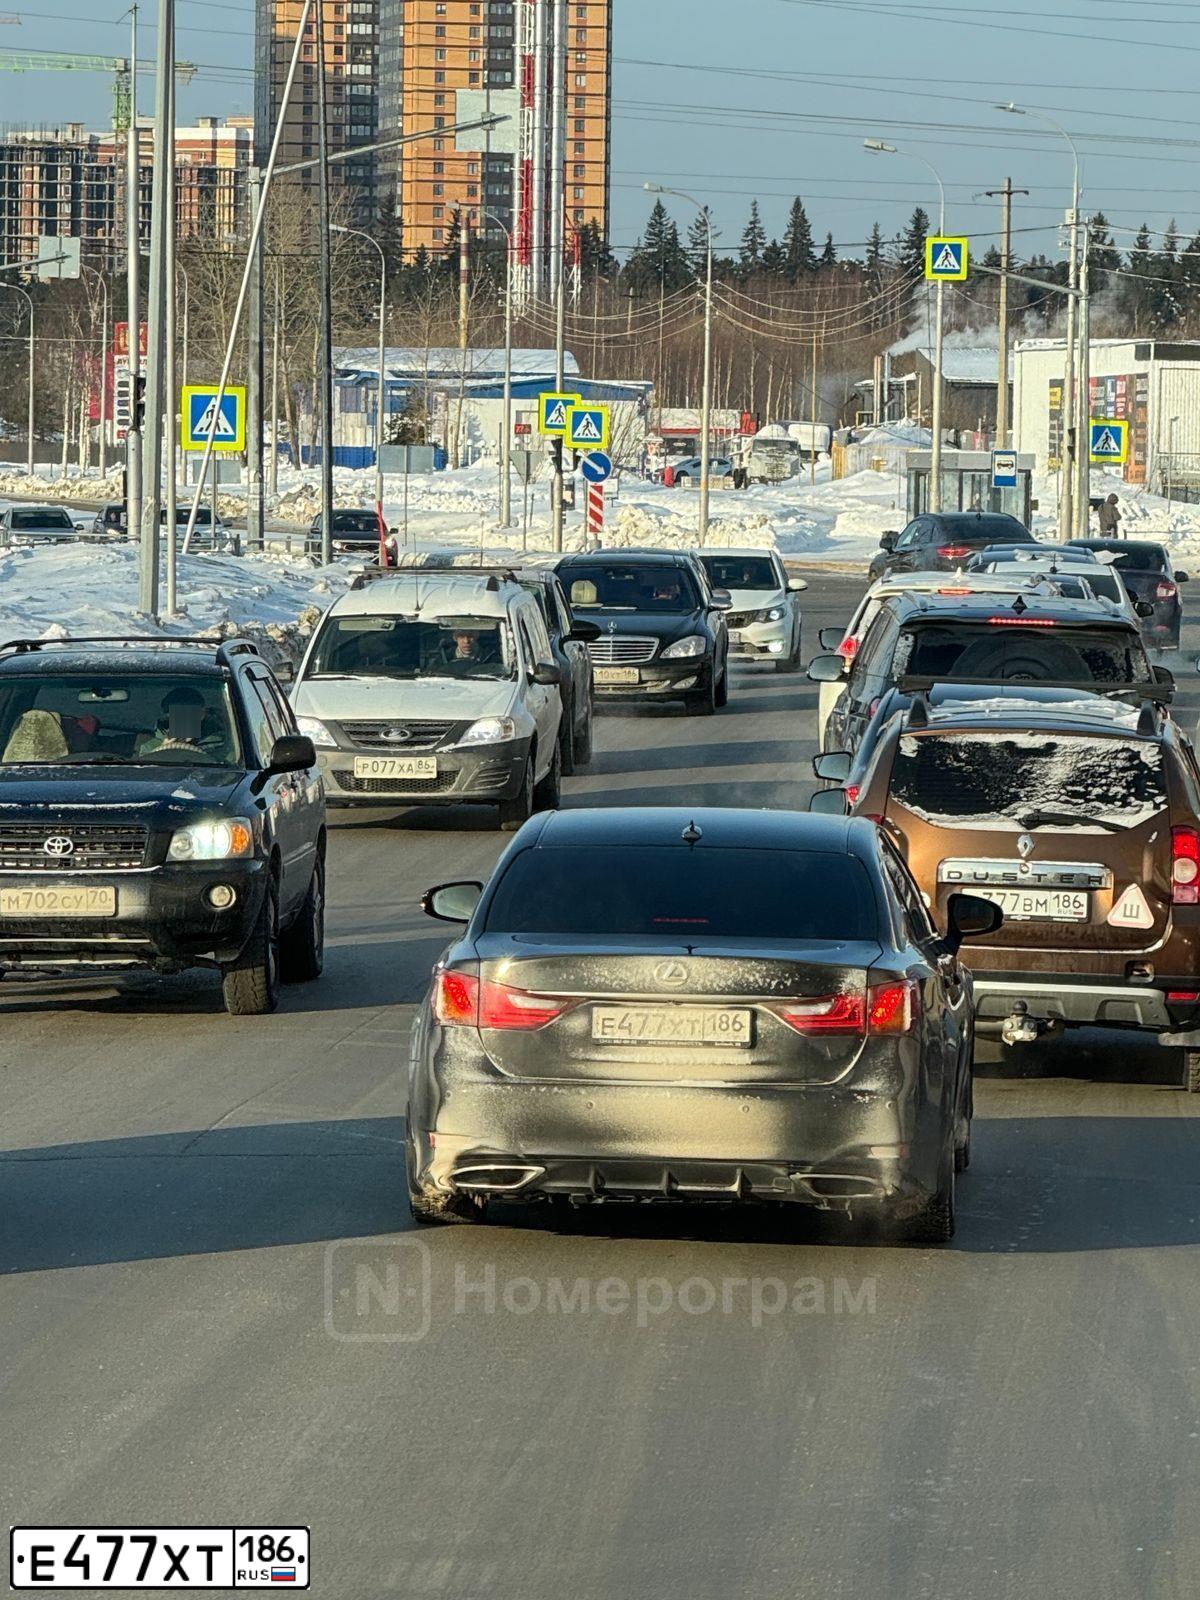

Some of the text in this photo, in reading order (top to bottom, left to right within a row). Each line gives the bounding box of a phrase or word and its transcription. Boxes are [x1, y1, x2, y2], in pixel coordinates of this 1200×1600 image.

[362, 760, 430, 774] Р077ХА 86
[947, 870, 1103, 886] DUSTER
[7, 890, 108, 909] М702СУ 70
[982, 892, 1081, 913] 777ВМ 186
[1123, 903, 1140, 919] Ш
[601, 1012, 743, 1036] Е477ХТ 186
